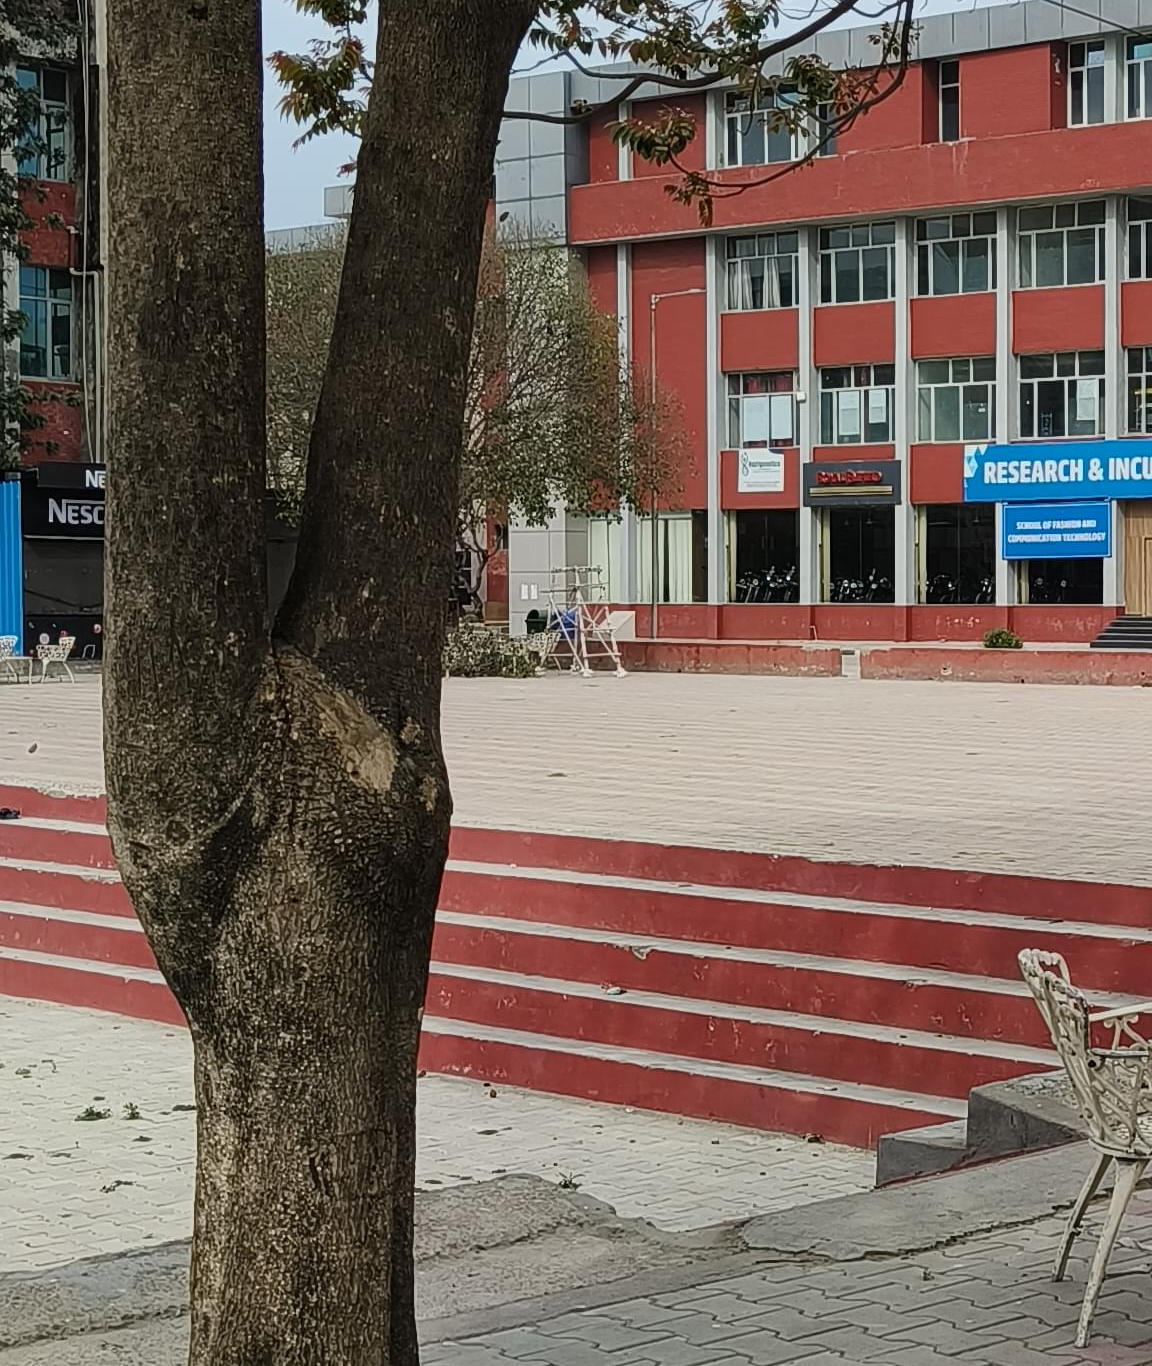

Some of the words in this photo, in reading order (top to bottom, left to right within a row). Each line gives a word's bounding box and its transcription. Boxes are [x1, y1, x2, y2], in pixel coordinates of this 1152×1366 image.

[984, 458, 1083, 484] RESEARCH
[1088, 457, 1104, 481] &
[48, 497, 106, 525] NESC
